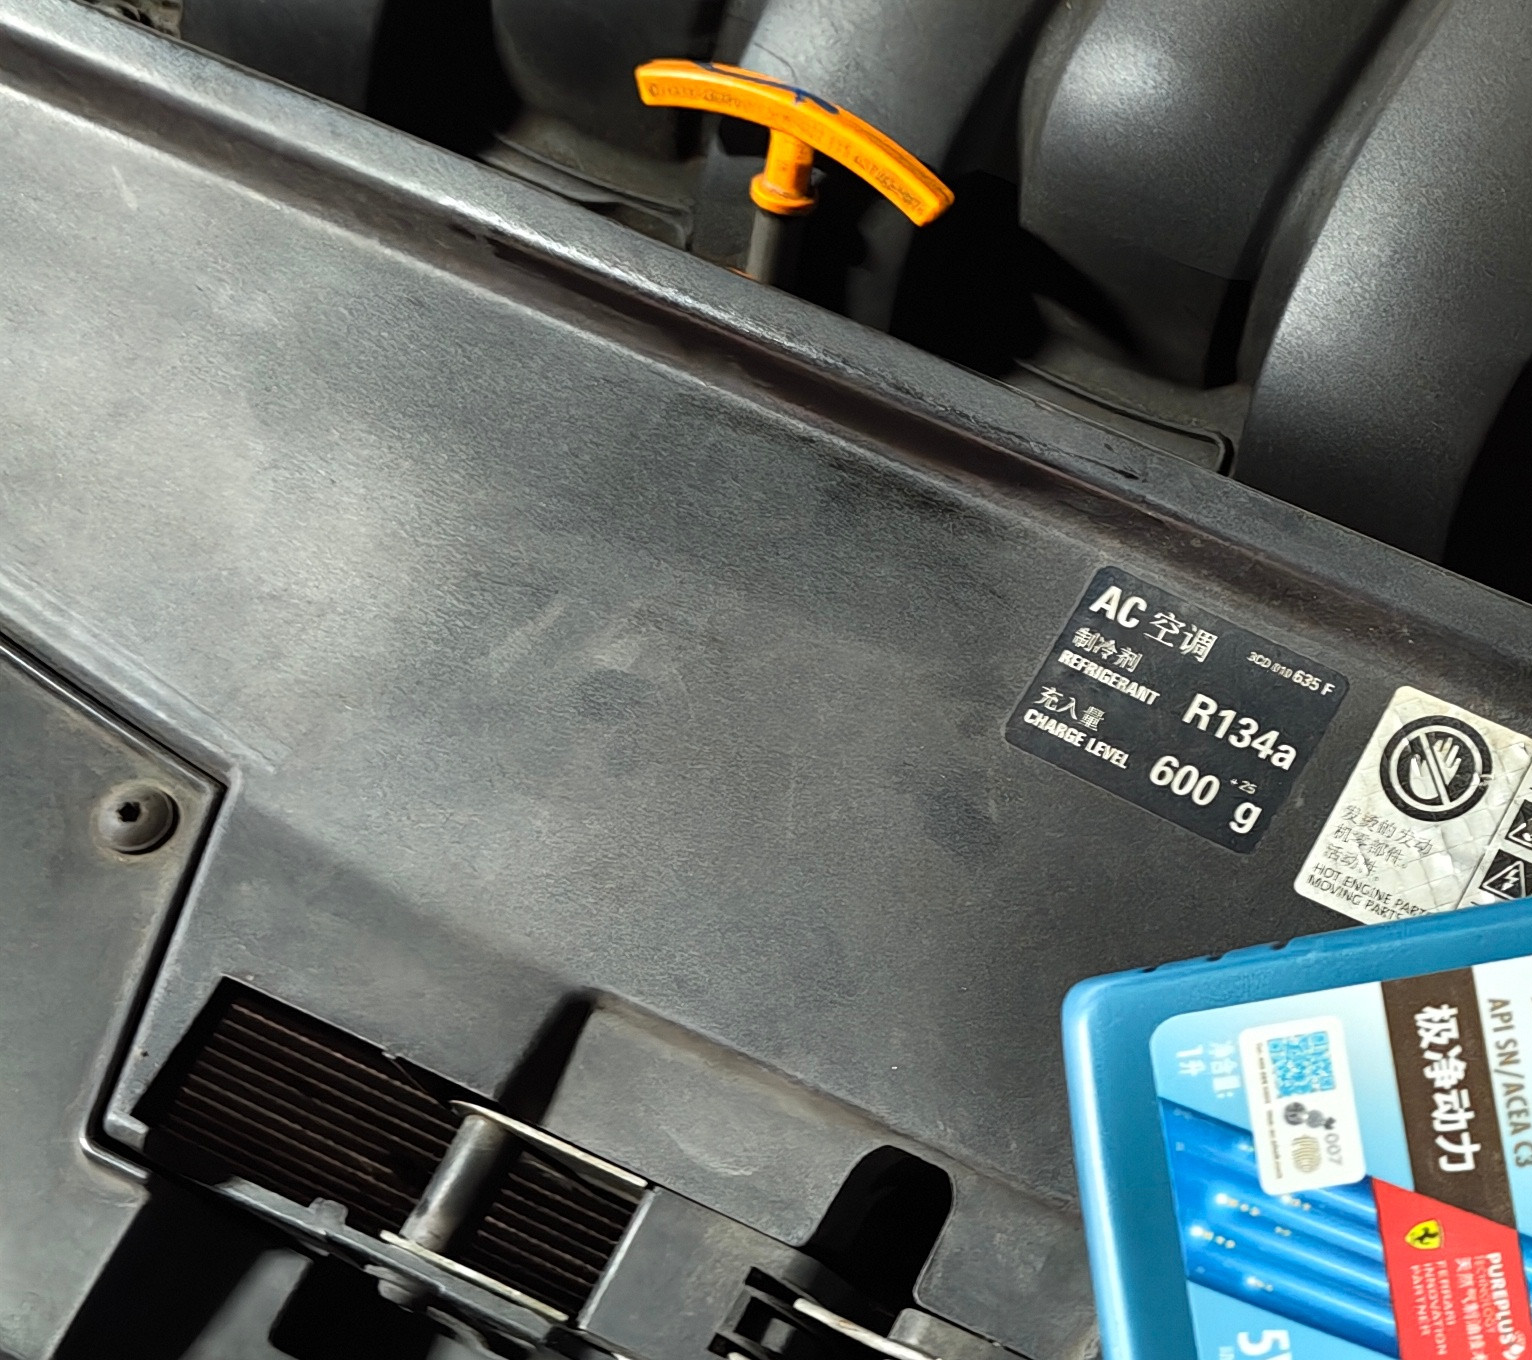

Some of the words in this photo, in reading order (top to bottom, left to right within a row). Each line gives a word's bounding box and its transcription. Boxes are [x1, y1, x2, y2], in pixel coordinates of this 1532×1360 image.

[1072, 626, 1143, 673] 制冷剂
[1088, 585, 1148, 629] AC
[1144, 611, 1218, 663] 空调
[1033, 685, 1105, 732] 充入量
[1057, 649, 1160, 706] REFRIGERANT
[1292, 670, 1322, 691] 635
[1321, 682, 1336, 696] F
[1023, 708, 1087, 748] CHARGE
[1085, 737, 1131, 770] LEVEL
[1181, 692, 1297, 771] R134a
[1149, 755, 1221, 807] 600
[1228, 801, 1263, 835] g
[1307, 874, 1361, 906] MOVING
[1313, 862, 1341, 882] HOT
[1343, 876, 1393, 904] ENGINE
[1394, 898, 1431, 915] PART
[1488, 998, 1514, 1033] API
[1414, 1004, 1481, 1172] 极净动力
[1494, 1037, 1531, 1136] SN/ACEA
[1410, 1264, 1431, 1336] PARTNER
[1423, 1262, 1447, 1355] INNOVATION
[1435, 1260, 1456, 1326] FERRARI
[1486, 1252, 1517, 1345] PUREPLUS
